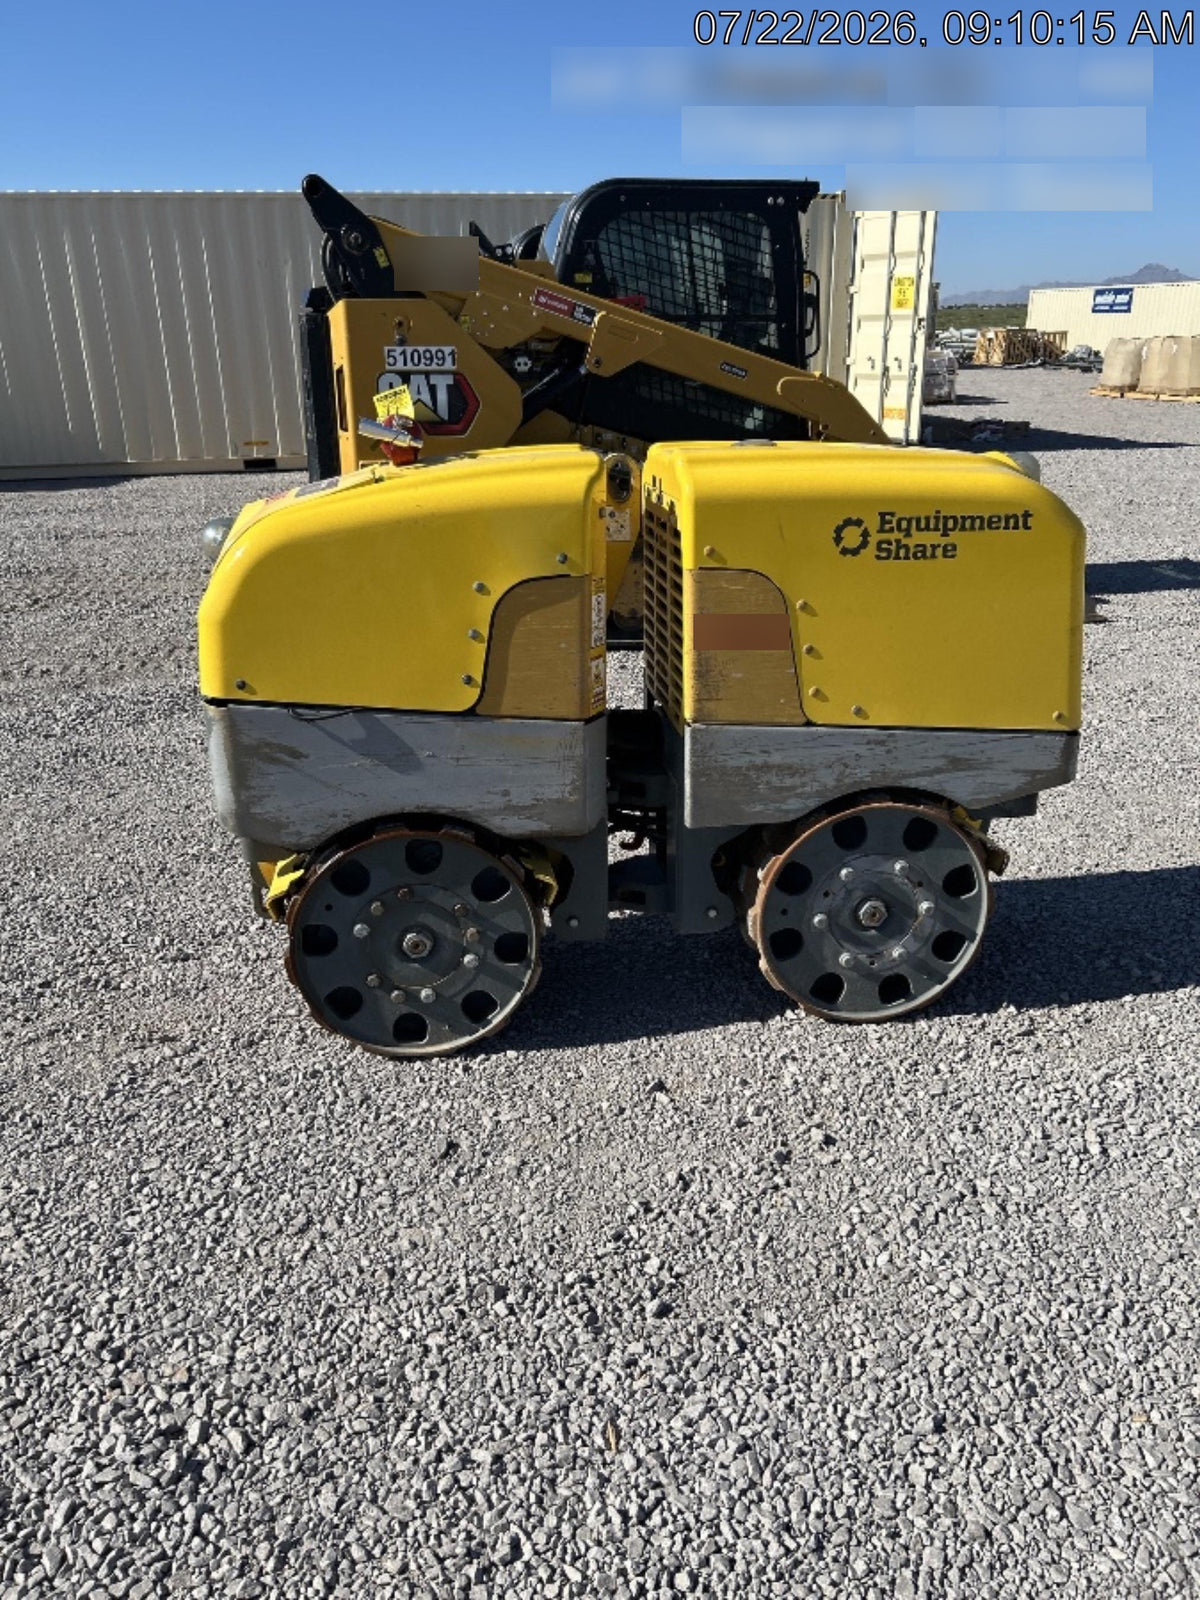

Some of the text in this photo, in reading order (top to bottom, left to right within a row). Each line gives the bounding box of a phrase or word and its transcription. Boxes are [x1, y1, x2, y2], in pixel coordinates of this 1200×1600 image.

[387, 348, 456, 367] 510991
[877, 510, 1034, 538] Equipment
[875, 538, 958, 561] Share
